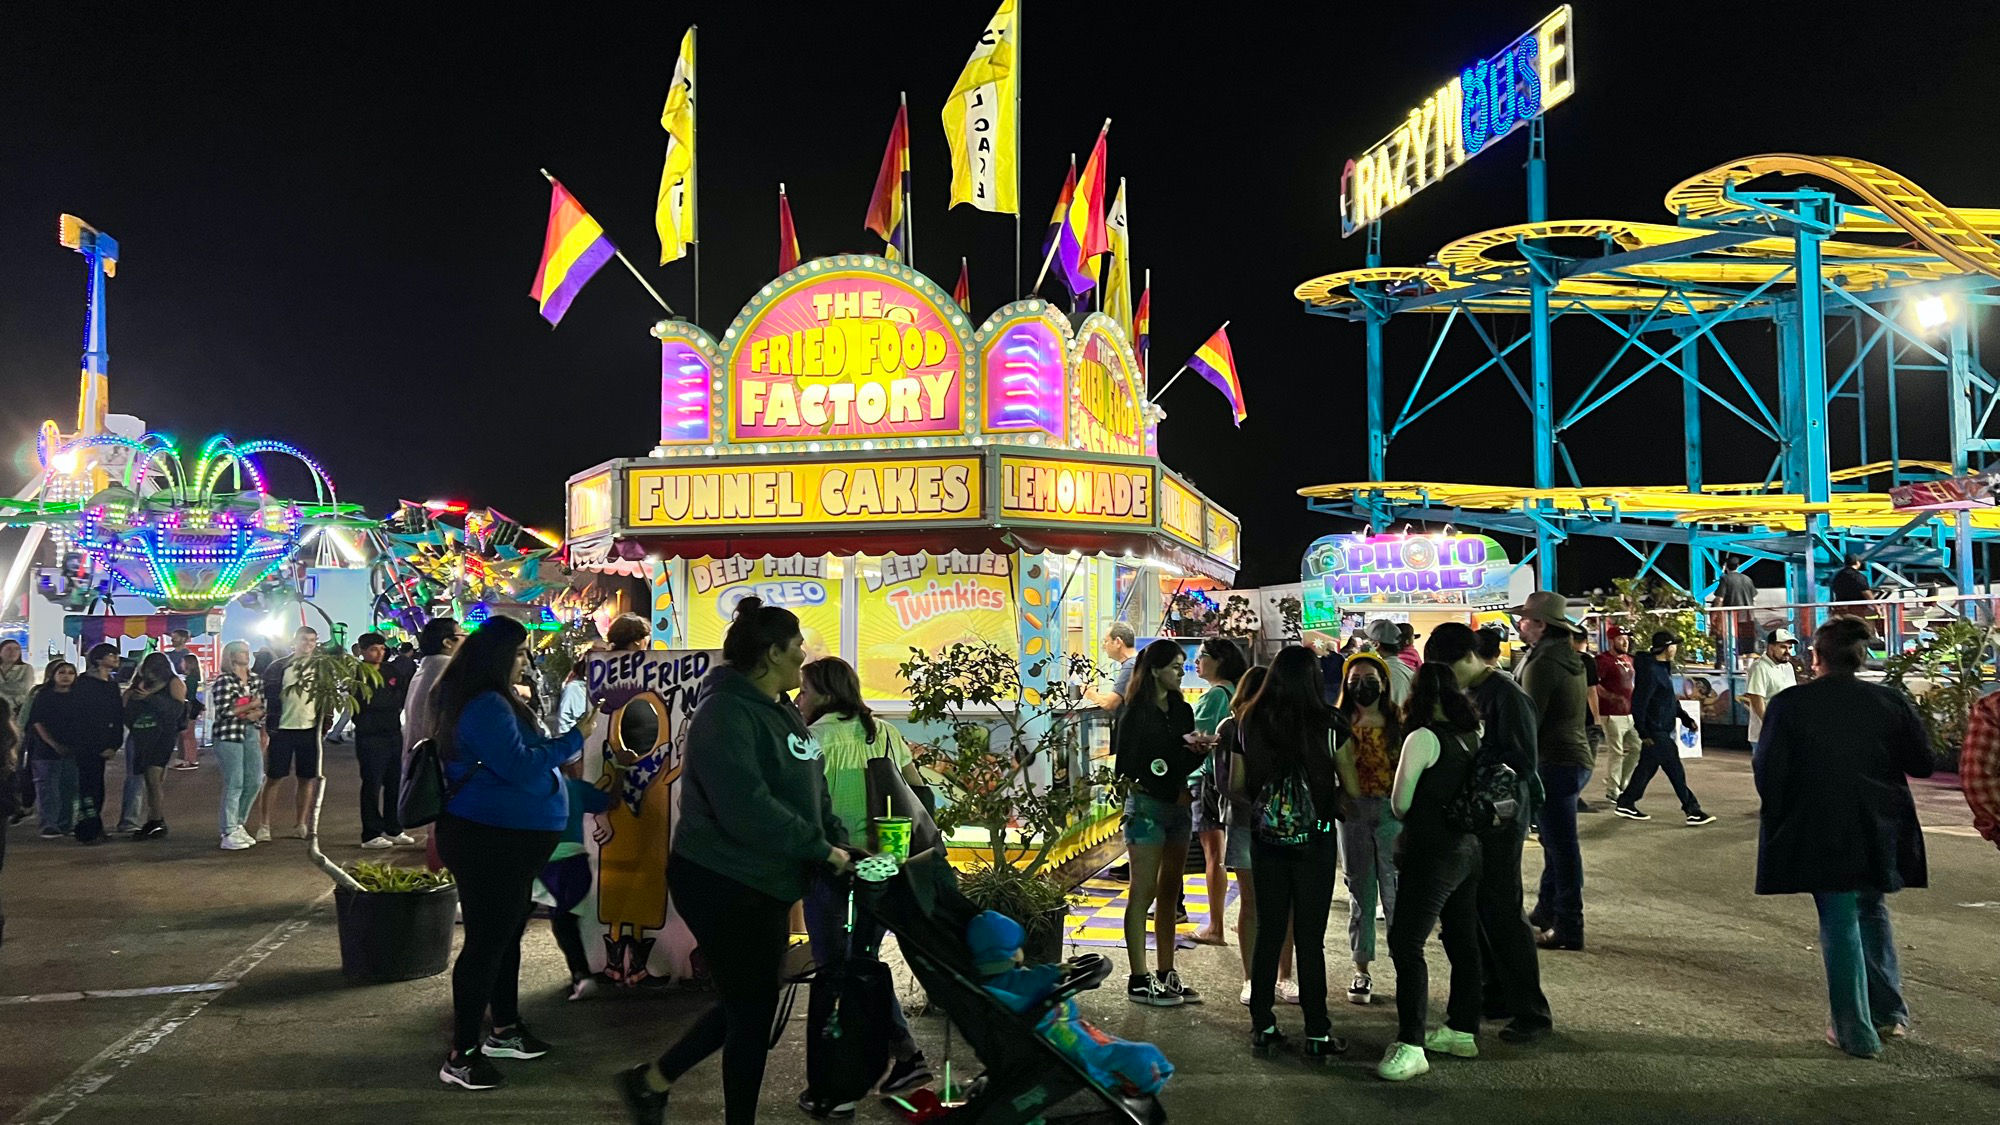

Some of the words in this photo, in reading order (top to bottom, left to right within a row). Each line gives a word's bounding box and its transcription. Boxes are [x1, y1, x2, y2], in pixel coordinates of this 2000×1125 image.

[1340, 97, 1435, 238] CRAZY
[1434, 8, 1573, 180] MOUSE
[813, 291, 882, 321] THE
[751, 325, 847, 376] FRIED
[861, 324, 947, 375] FOOD
[741, 371, 956, 427] FACTORY
[637, 472, 803, 521] FUNNEL
[820, 466, 971, 517] CAKES
[1003, 464, 1149, 518] LEMONADE
[171, 533, 230, 544] TORNADO
[691, 557, 755, 594] DEEP
[936, 552, 1012, 577] FRIED
[1323, 568, 1487, 595] MEMORIES
[717, 580, 827, 622] OREO
[889, 580, 1004, 627] Twinkies
[589, 650, 645, 691] DEEP
[642, 651, 710, 692] FRIED
